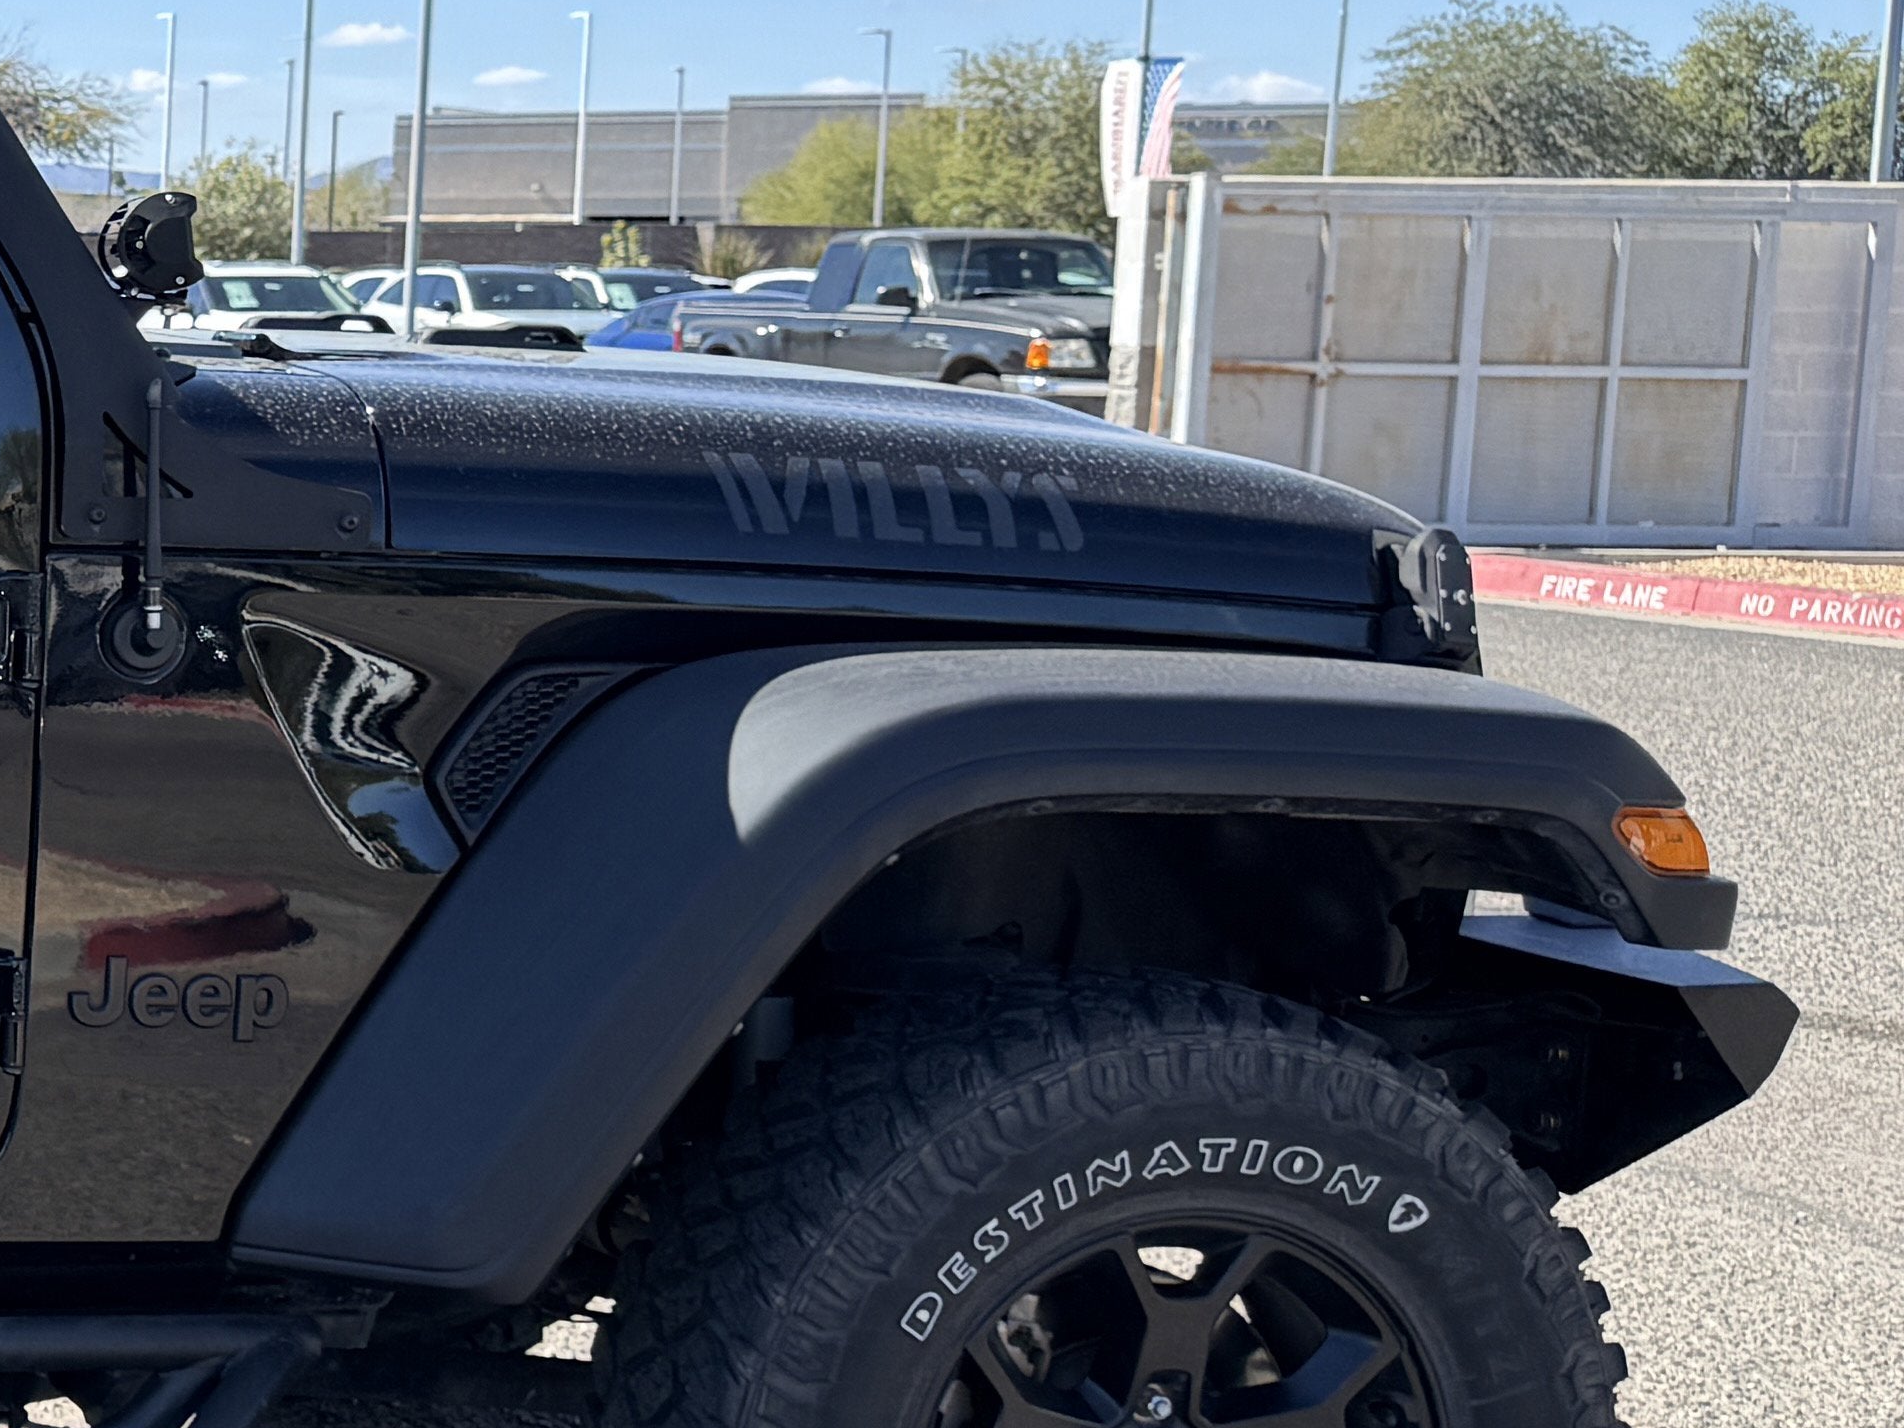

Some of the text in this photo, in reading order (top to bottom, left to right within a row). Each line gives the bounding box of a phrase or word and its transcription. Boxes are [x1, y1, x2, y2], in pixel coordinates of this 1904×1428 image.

[702, 450, 1085, 553] WILLYS
[1539, 574, 1904, 630] FIRE LANE NO PARKING
[67, 956, 289, 1043] Jeep
[900, 1137, 1382, 1342] DESTINATION
